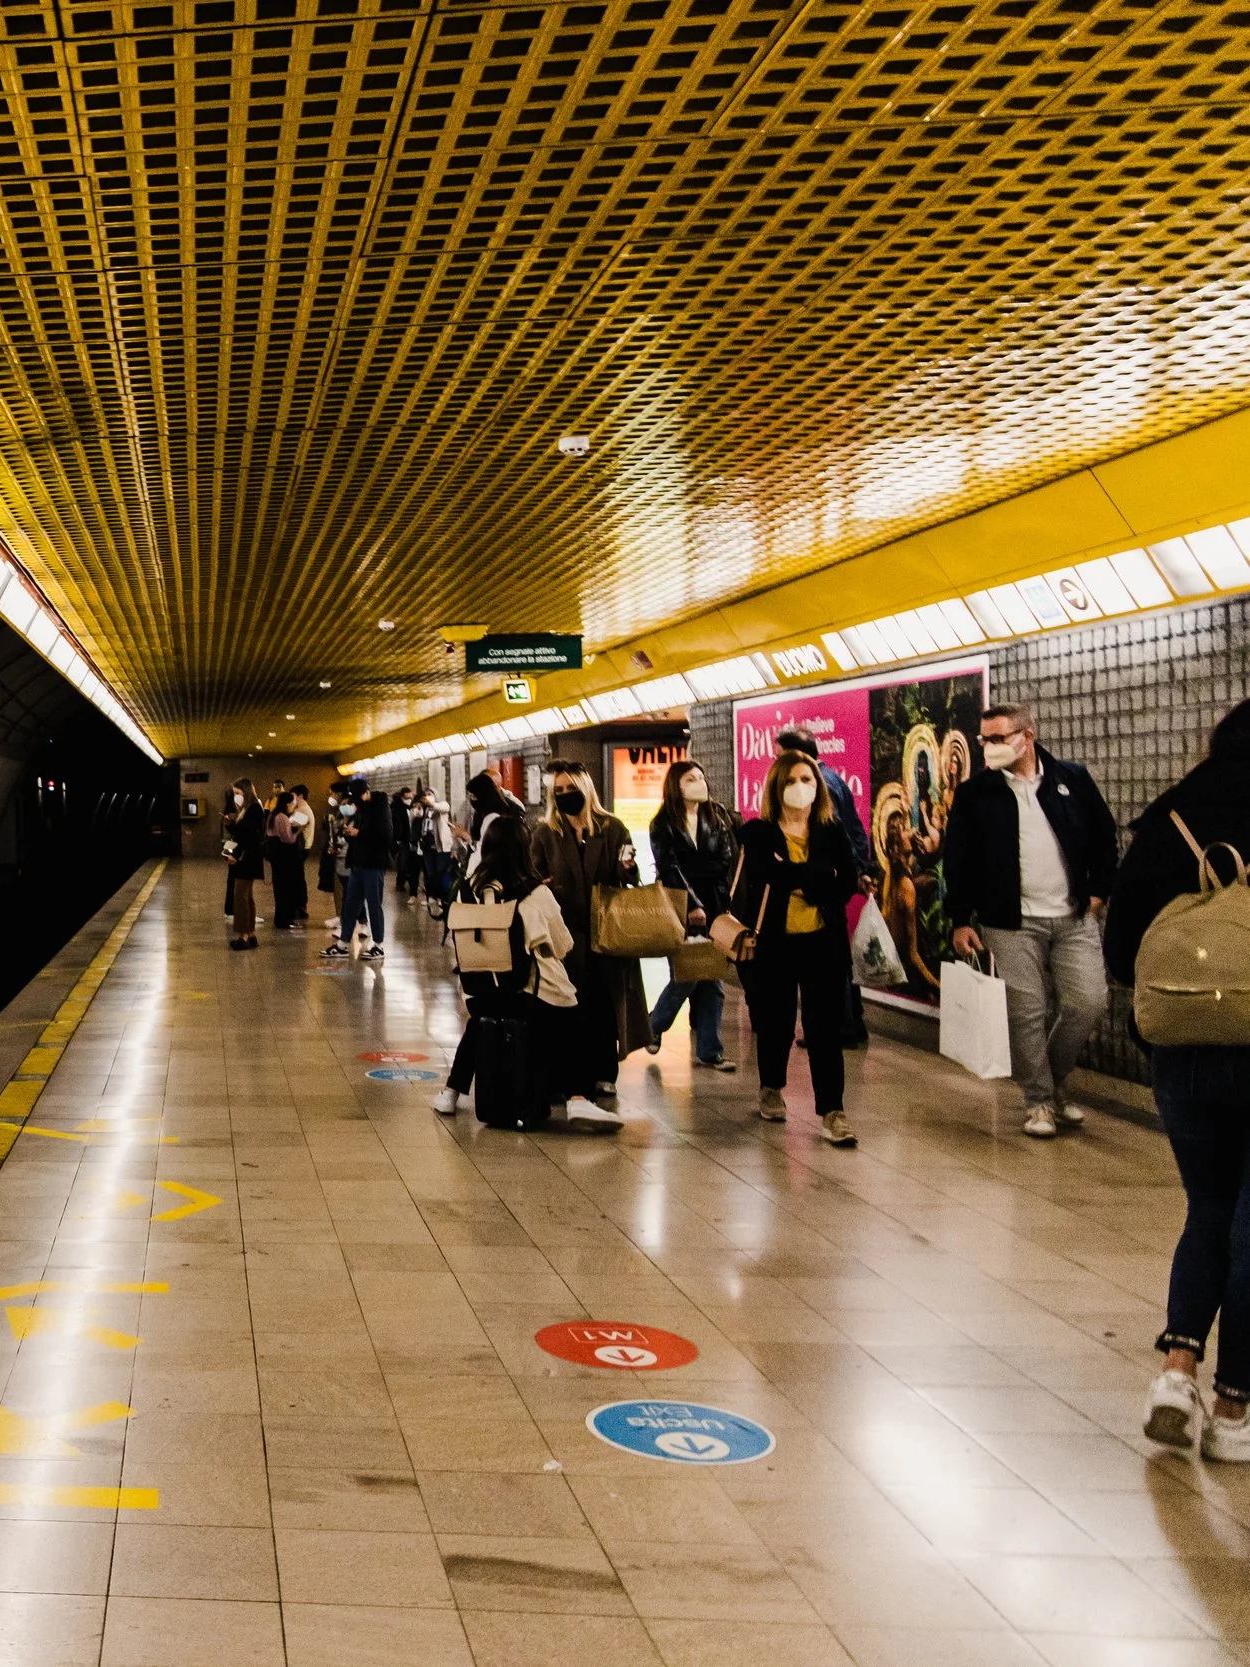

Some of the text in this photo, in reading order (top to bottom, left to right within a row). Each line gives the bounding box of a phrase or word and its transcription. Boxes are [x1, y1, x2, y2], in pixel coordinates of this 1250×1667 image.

[488, 647, 556, 658] Con segnale attivo
[478, 656, 527, 665] abbandonare
[536, 654, 568, 663] stazione
[771, 643, 828, 678] DUOMO
[582, 1329, 634, 1341] M1
[627, 1417, 725, 1431] Uscita
